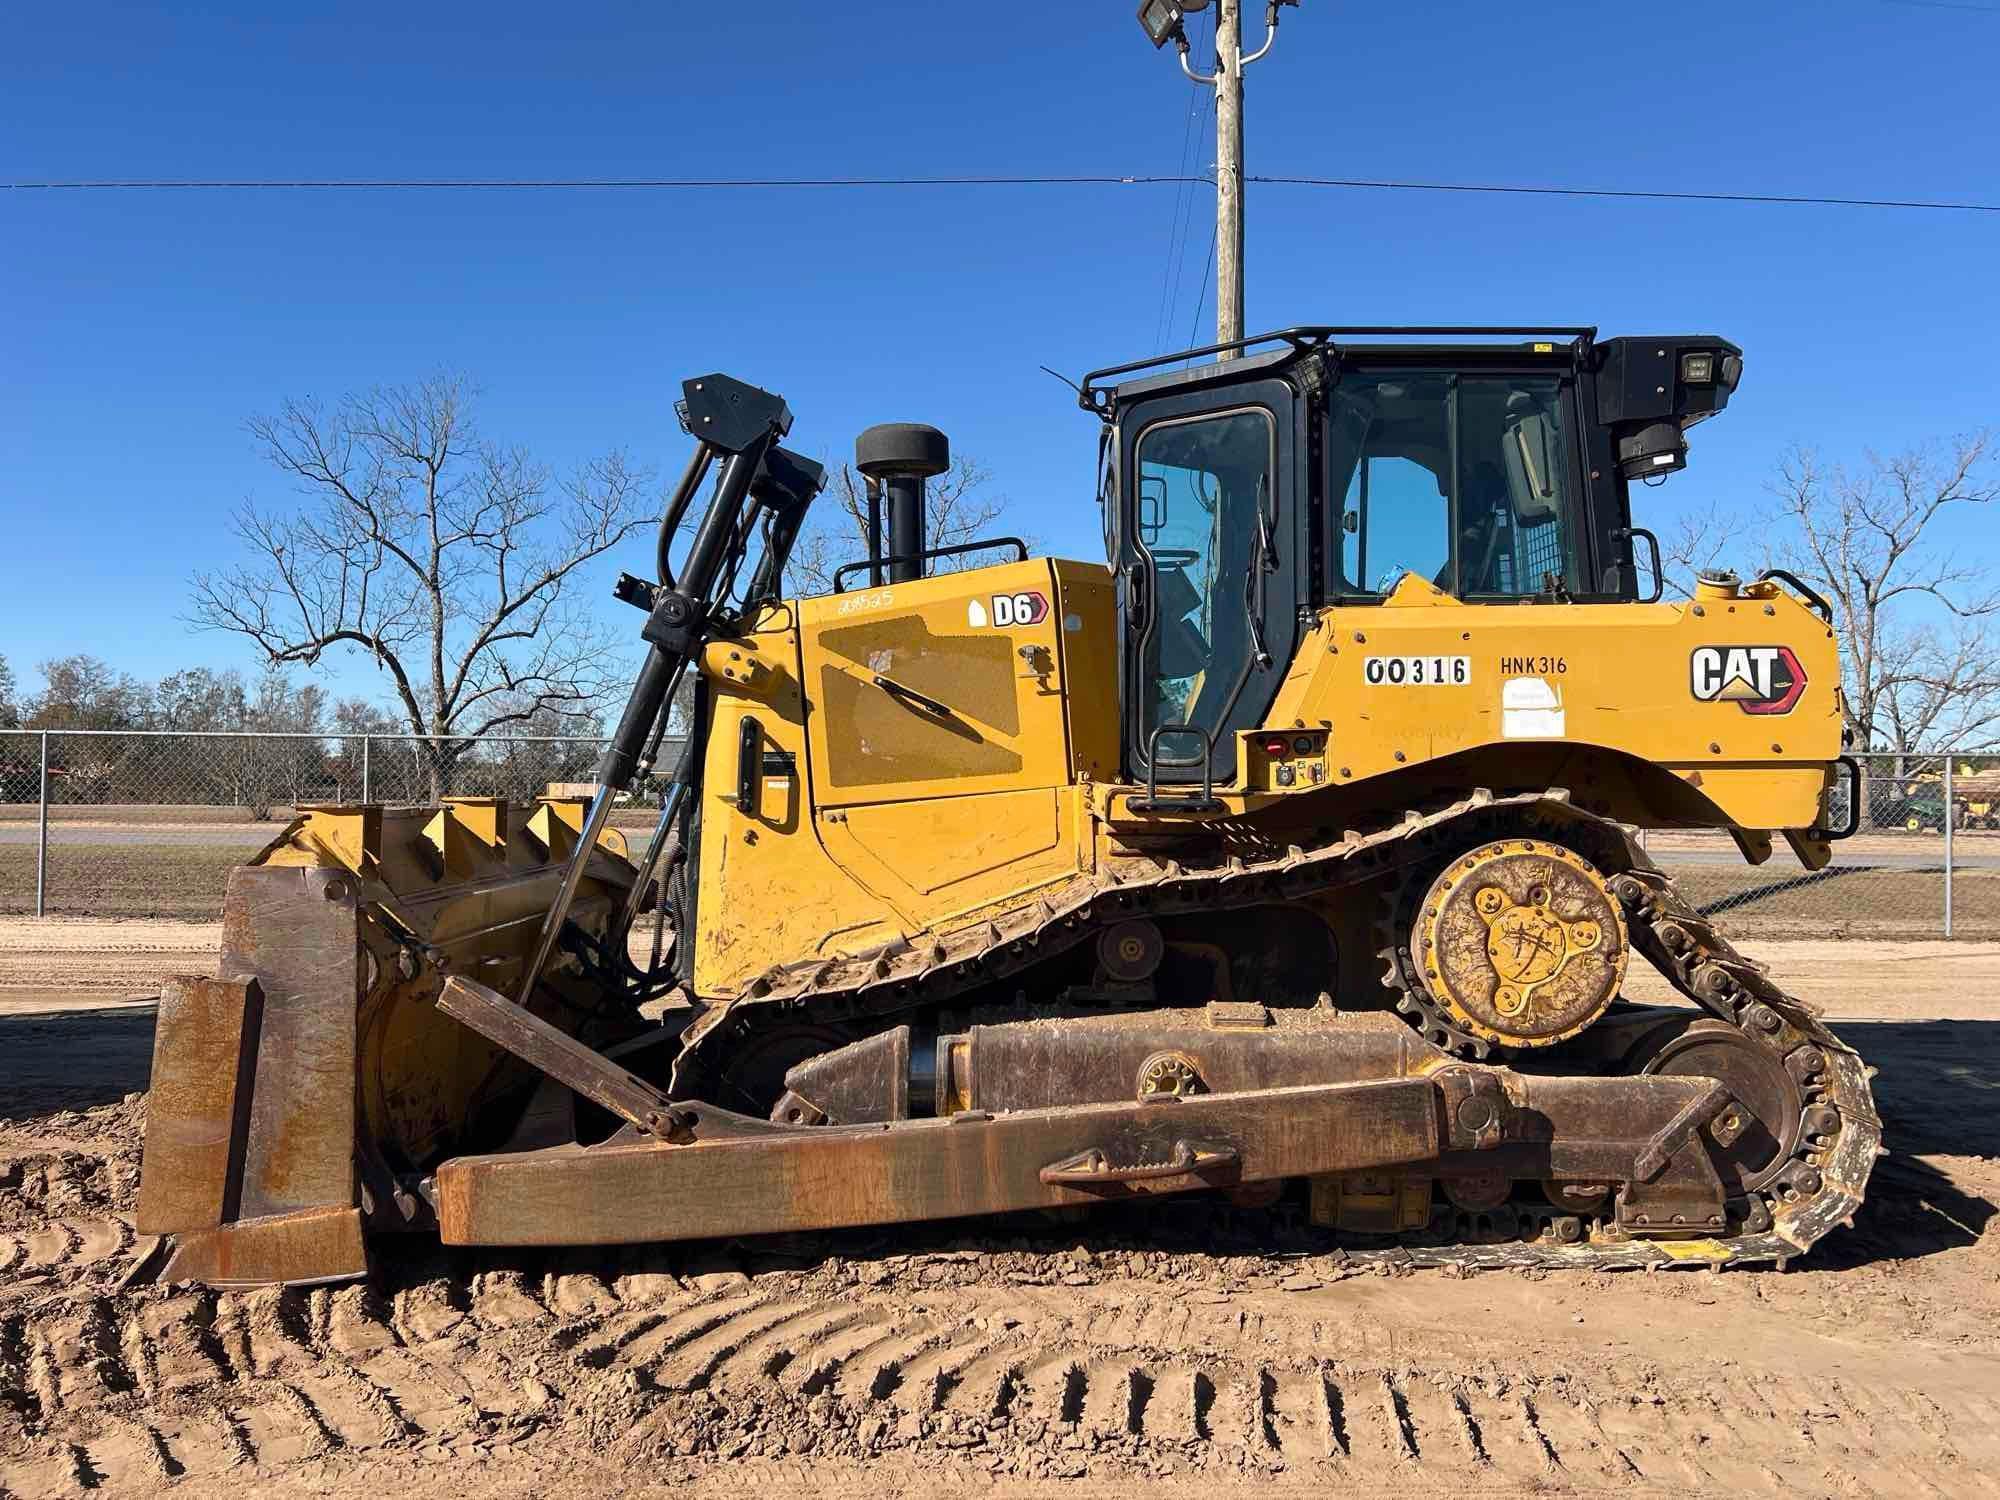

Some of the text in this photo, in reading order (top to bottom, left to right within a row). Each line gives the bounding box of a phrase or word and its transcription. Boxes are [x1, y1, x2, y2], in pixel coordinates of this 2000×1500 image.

[992, 593, 1033, 627] D6
[1366, 658, 1465, 684] 00316
[1501, 657, 1567, 674] HNK316
[1692, 648, 1778, 699] CAT
